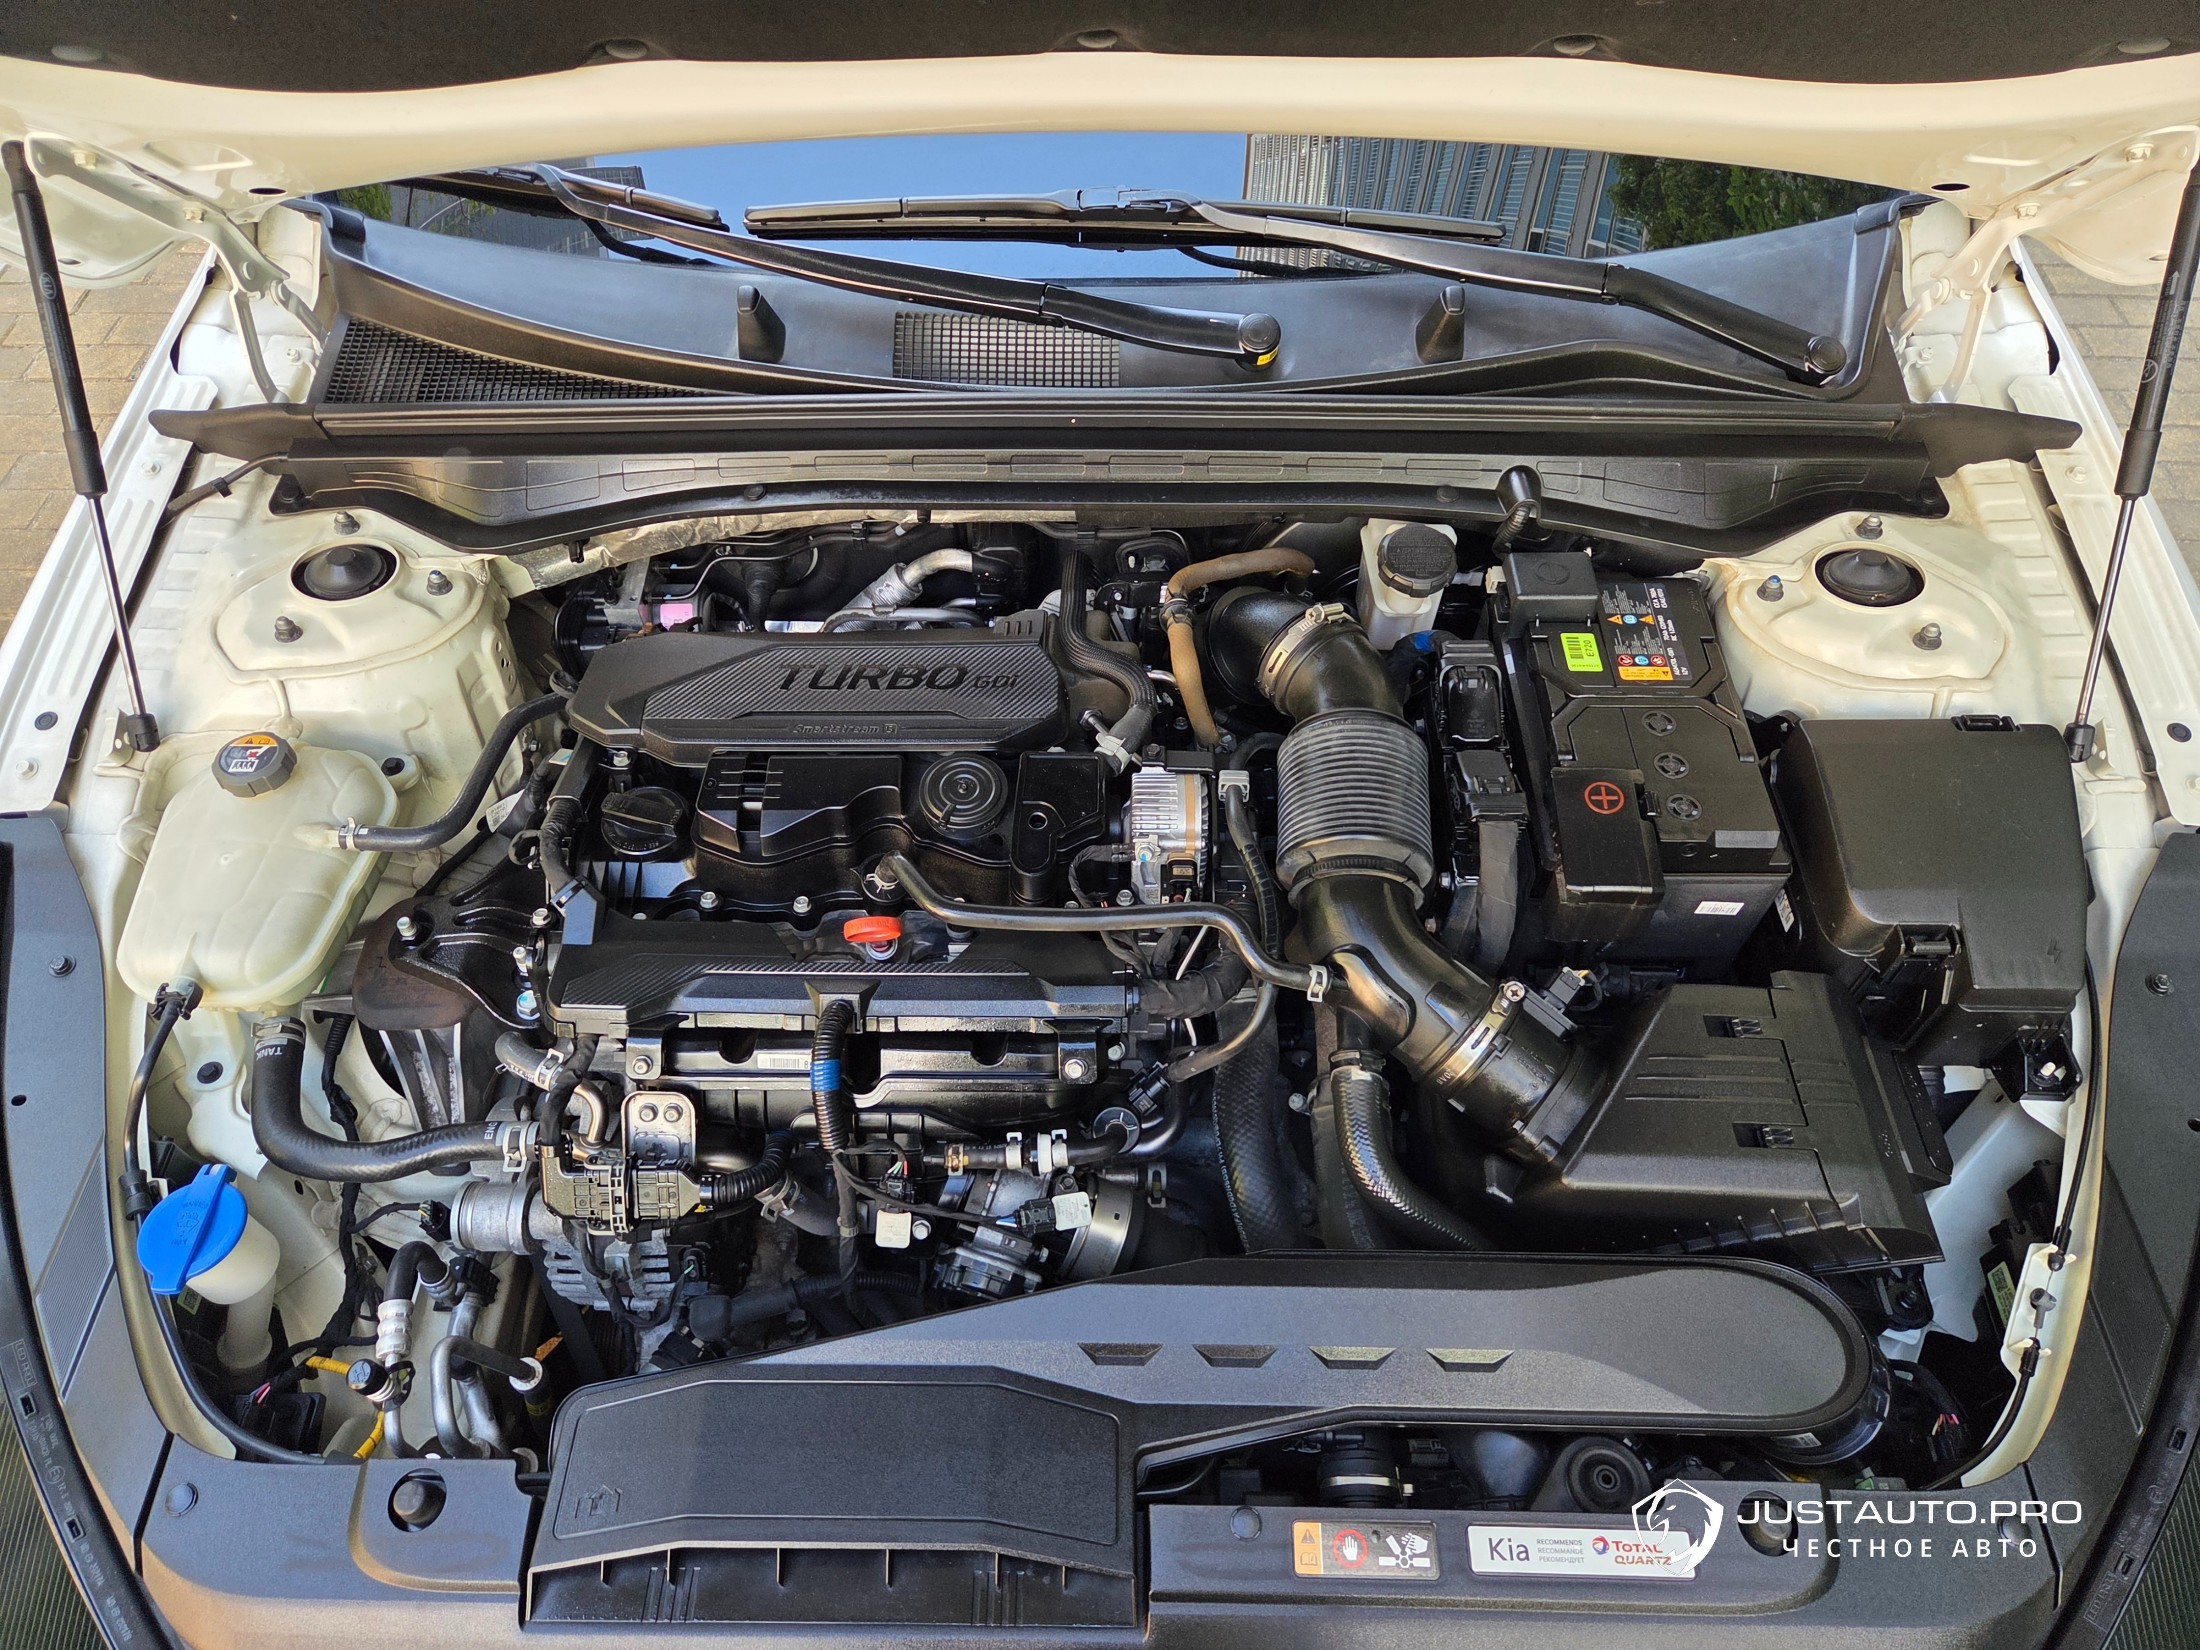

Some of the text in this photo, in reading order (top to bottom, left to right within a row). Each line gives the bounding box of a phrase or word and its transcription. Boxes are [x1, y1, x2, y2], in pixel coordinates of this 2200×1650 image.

[1583, 640, 1595, 657] E720
[778, 663, 1019, 691] TURBO GDi
[793, 723, 880, 735] Smartstream
[256, 1046, 283, 1061] TANK
[1536, 1538, 1583, 1546] RECOMMENDS
[1611, 1540, 1663, 1554] TOTAL
[1488, 1537, 1531, 1562] Kia
[1537, 1547, 1584, 1555] RECOMMANDE
[1539, 1555, 1585, 1564] РЕКОМЕНДУЕТ
[1614, 1555, 1672, 1566] QUARTZ
